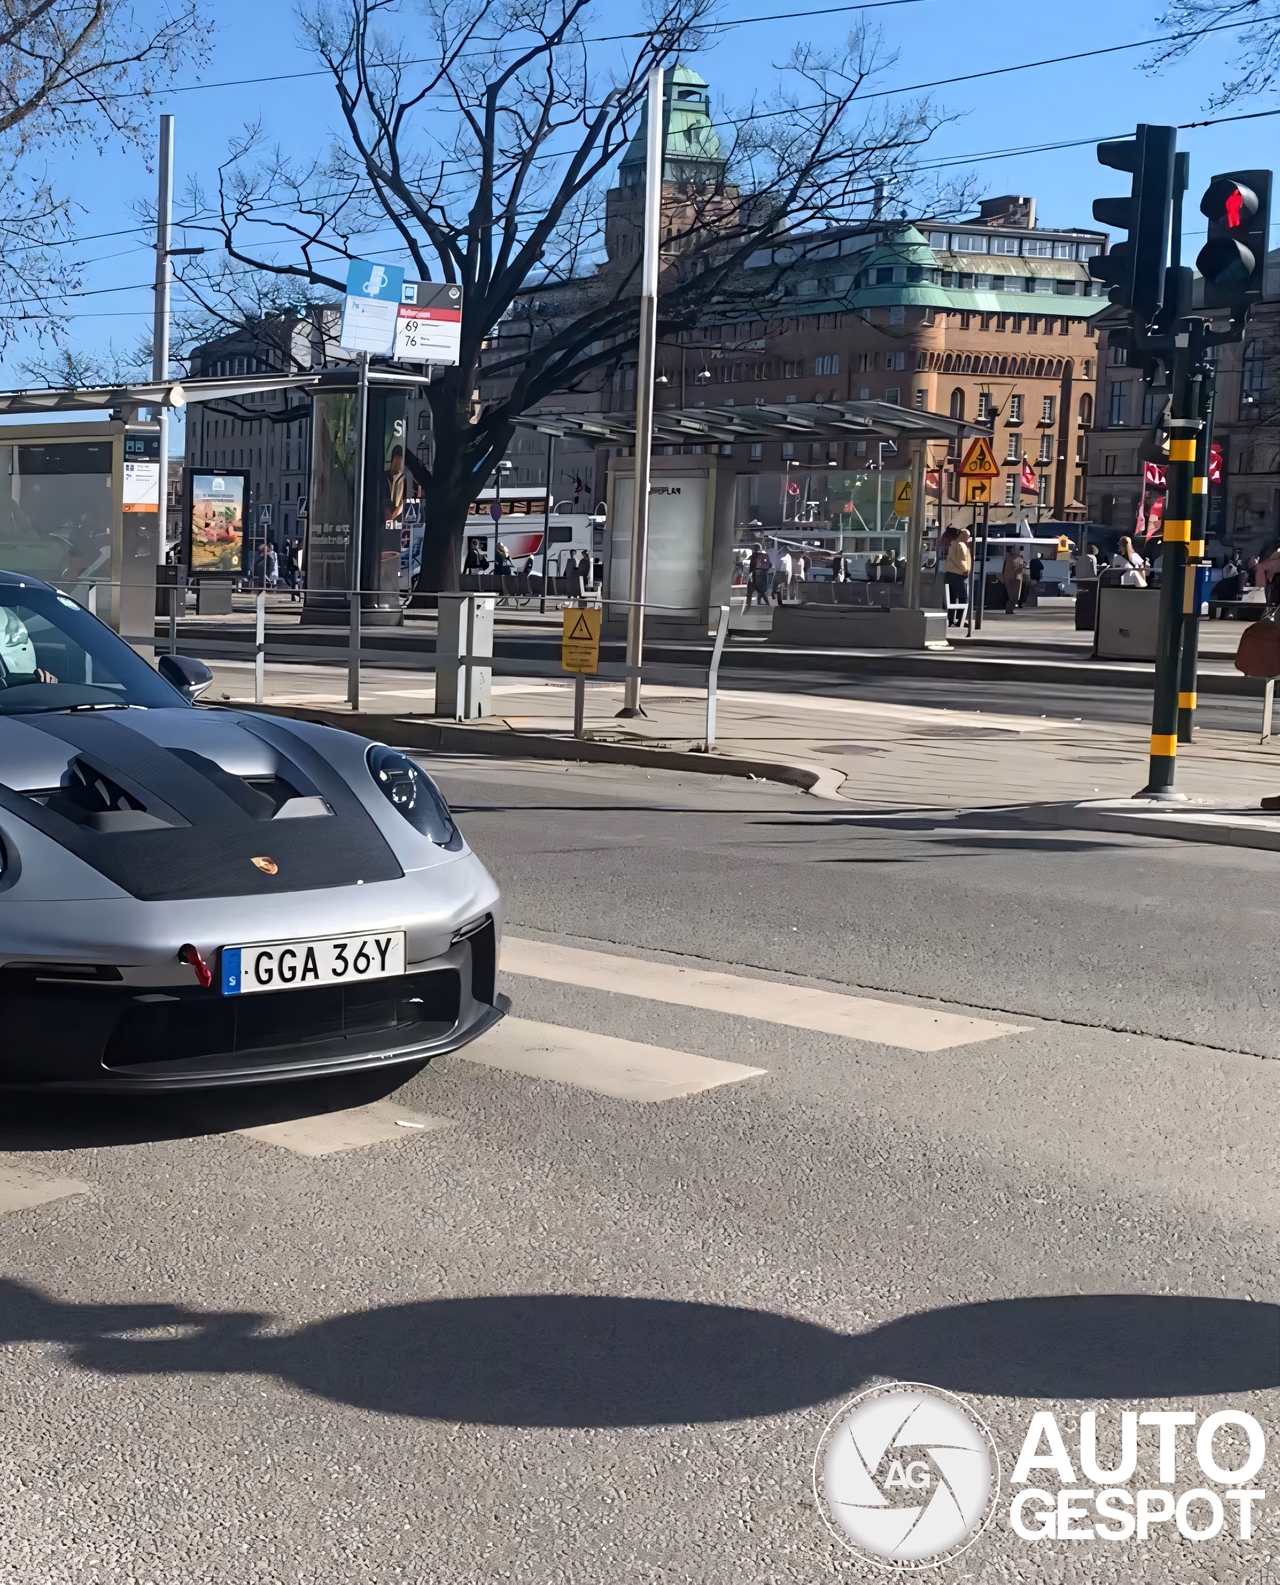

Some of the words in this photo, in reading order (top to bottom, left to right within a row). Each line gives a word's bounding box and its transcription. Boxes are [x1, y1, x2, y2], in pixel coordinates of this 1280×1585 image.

[405, 320, 419, 332] 69
[405, 335, 417, 347] 76
[228, 975, 237, 987] S
[254, 946, 320, 986] GGA
[331, 937, 392, 977] 36Y
